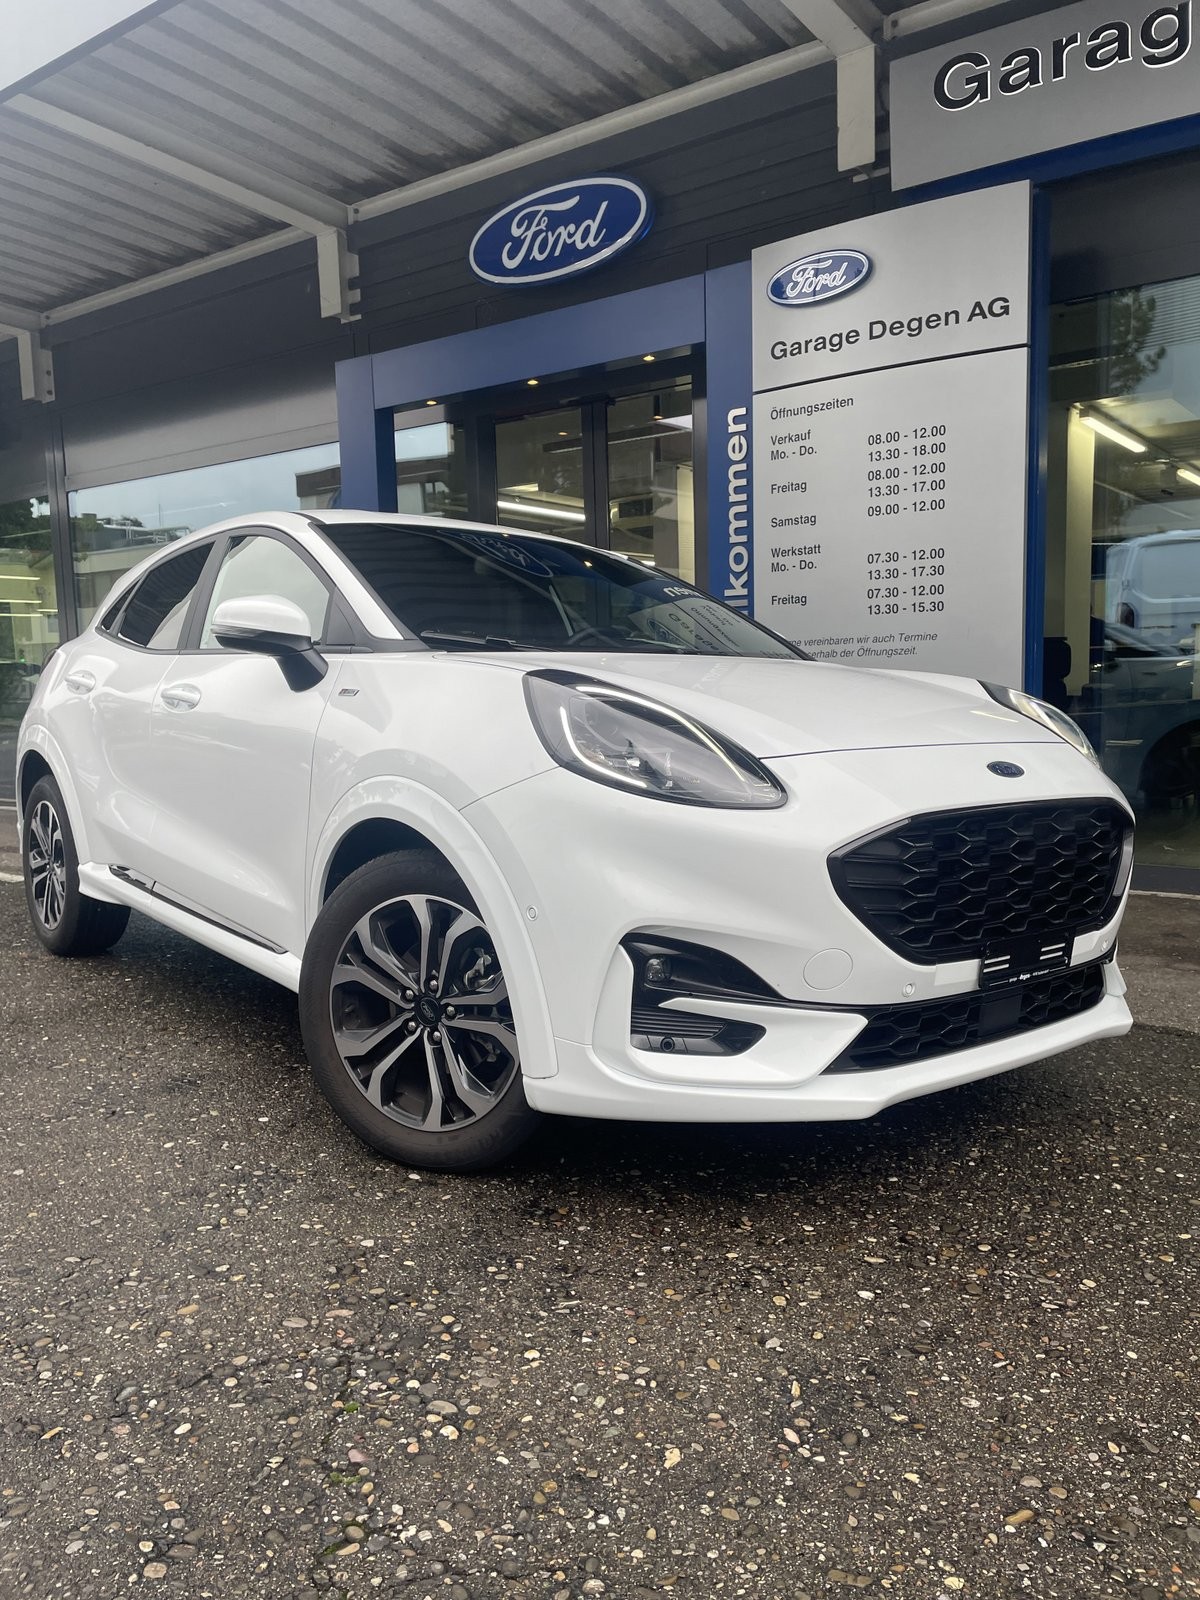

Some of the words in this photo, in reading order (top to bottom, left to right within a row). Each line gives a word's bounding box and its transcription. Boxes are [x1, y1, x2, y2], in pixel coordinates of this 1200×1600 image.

[502, 195, 608, 269] Ford
[786, 259, 848, 297] Ford
[770, 328, 861, 360] Garage
[869, 308, 961, 341] Degen
[967, 296, 1011, 322] AG
[771, 398, 853, 420] Öffnungszeiten
[771, 429, 811, 445] Verkauf
[867, 432, 901, 446] 08.00
[912, 424, 947, 440] 12.00
[770, 449, 790, 461] Mo.
[798, 444, 818, 457] Do.
[867, 448, 900, 463] 13.30
[912, 441, 946, 457] 18.00
[867, 467, 900, 482] 08.00
[912, 461, 946, 477] 12.00
[771, 482, 807, 494] Freitag
[867, 485, 900, 499] 13.30
[912, 479, 946, 494] 17.00
[724, 406, 749, 616] lkommen
[867, 503, 900, 518] 09.00
[912, 498, 946, 513] 12.00
[771, 515, 816, 528] Samstag
[771, 544, 821, 558] Werkstatt
[867, 551, 899, 565] 07.30
[911, 547, 945, 561] 12.00
[771, 561, 790, 573] Mo.
[799, 558, 818, 571] Do.
[867, 567, 899, 581] 13.30
[911, 564, 945, 578] 17.30
[772, 594, 807, 606] Freitag
[867, 587, 899, 600] 07.30
[911, 583, 945, 597] 12.00
[867, 604, 899, 616] 13.30
[911, 600, 945, 614] 15.30
[804, 635, 854, 647] vereinbaren
[856, 635, 870, 644] wir
[871, 633, 895, 644] auch
[899, 631, 938, 643] Termine
[839, 648, 854, 658] der
[857, 645, 918, 658] Öffnungszeit.
